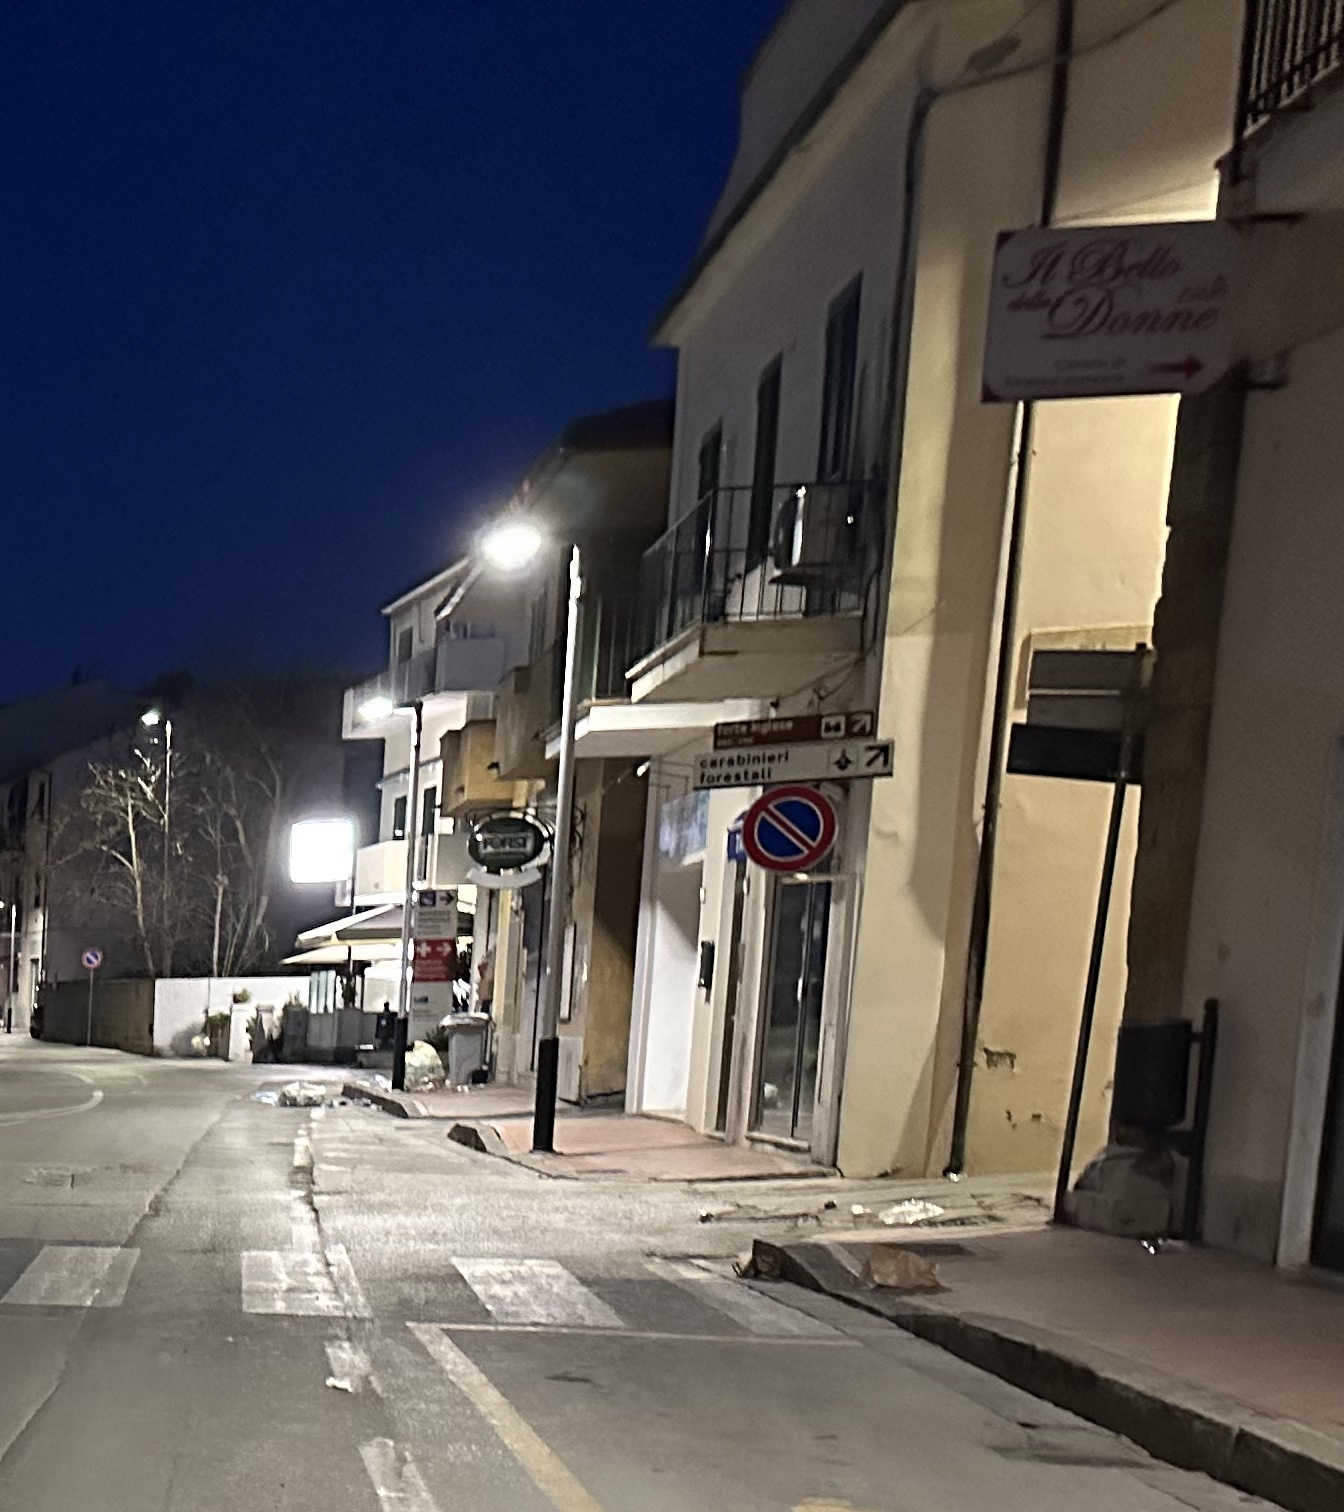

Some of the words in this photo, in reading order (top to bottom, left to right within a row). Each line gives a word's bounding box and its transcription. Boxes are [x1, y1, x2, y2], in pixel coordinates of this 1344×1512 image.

[1041, 285, 1220, 339] Donne
[699, 750, 789, 769] carabinieri
[699, 768, 772, 784] forestali
[483, 836, 528, 850] FORST
